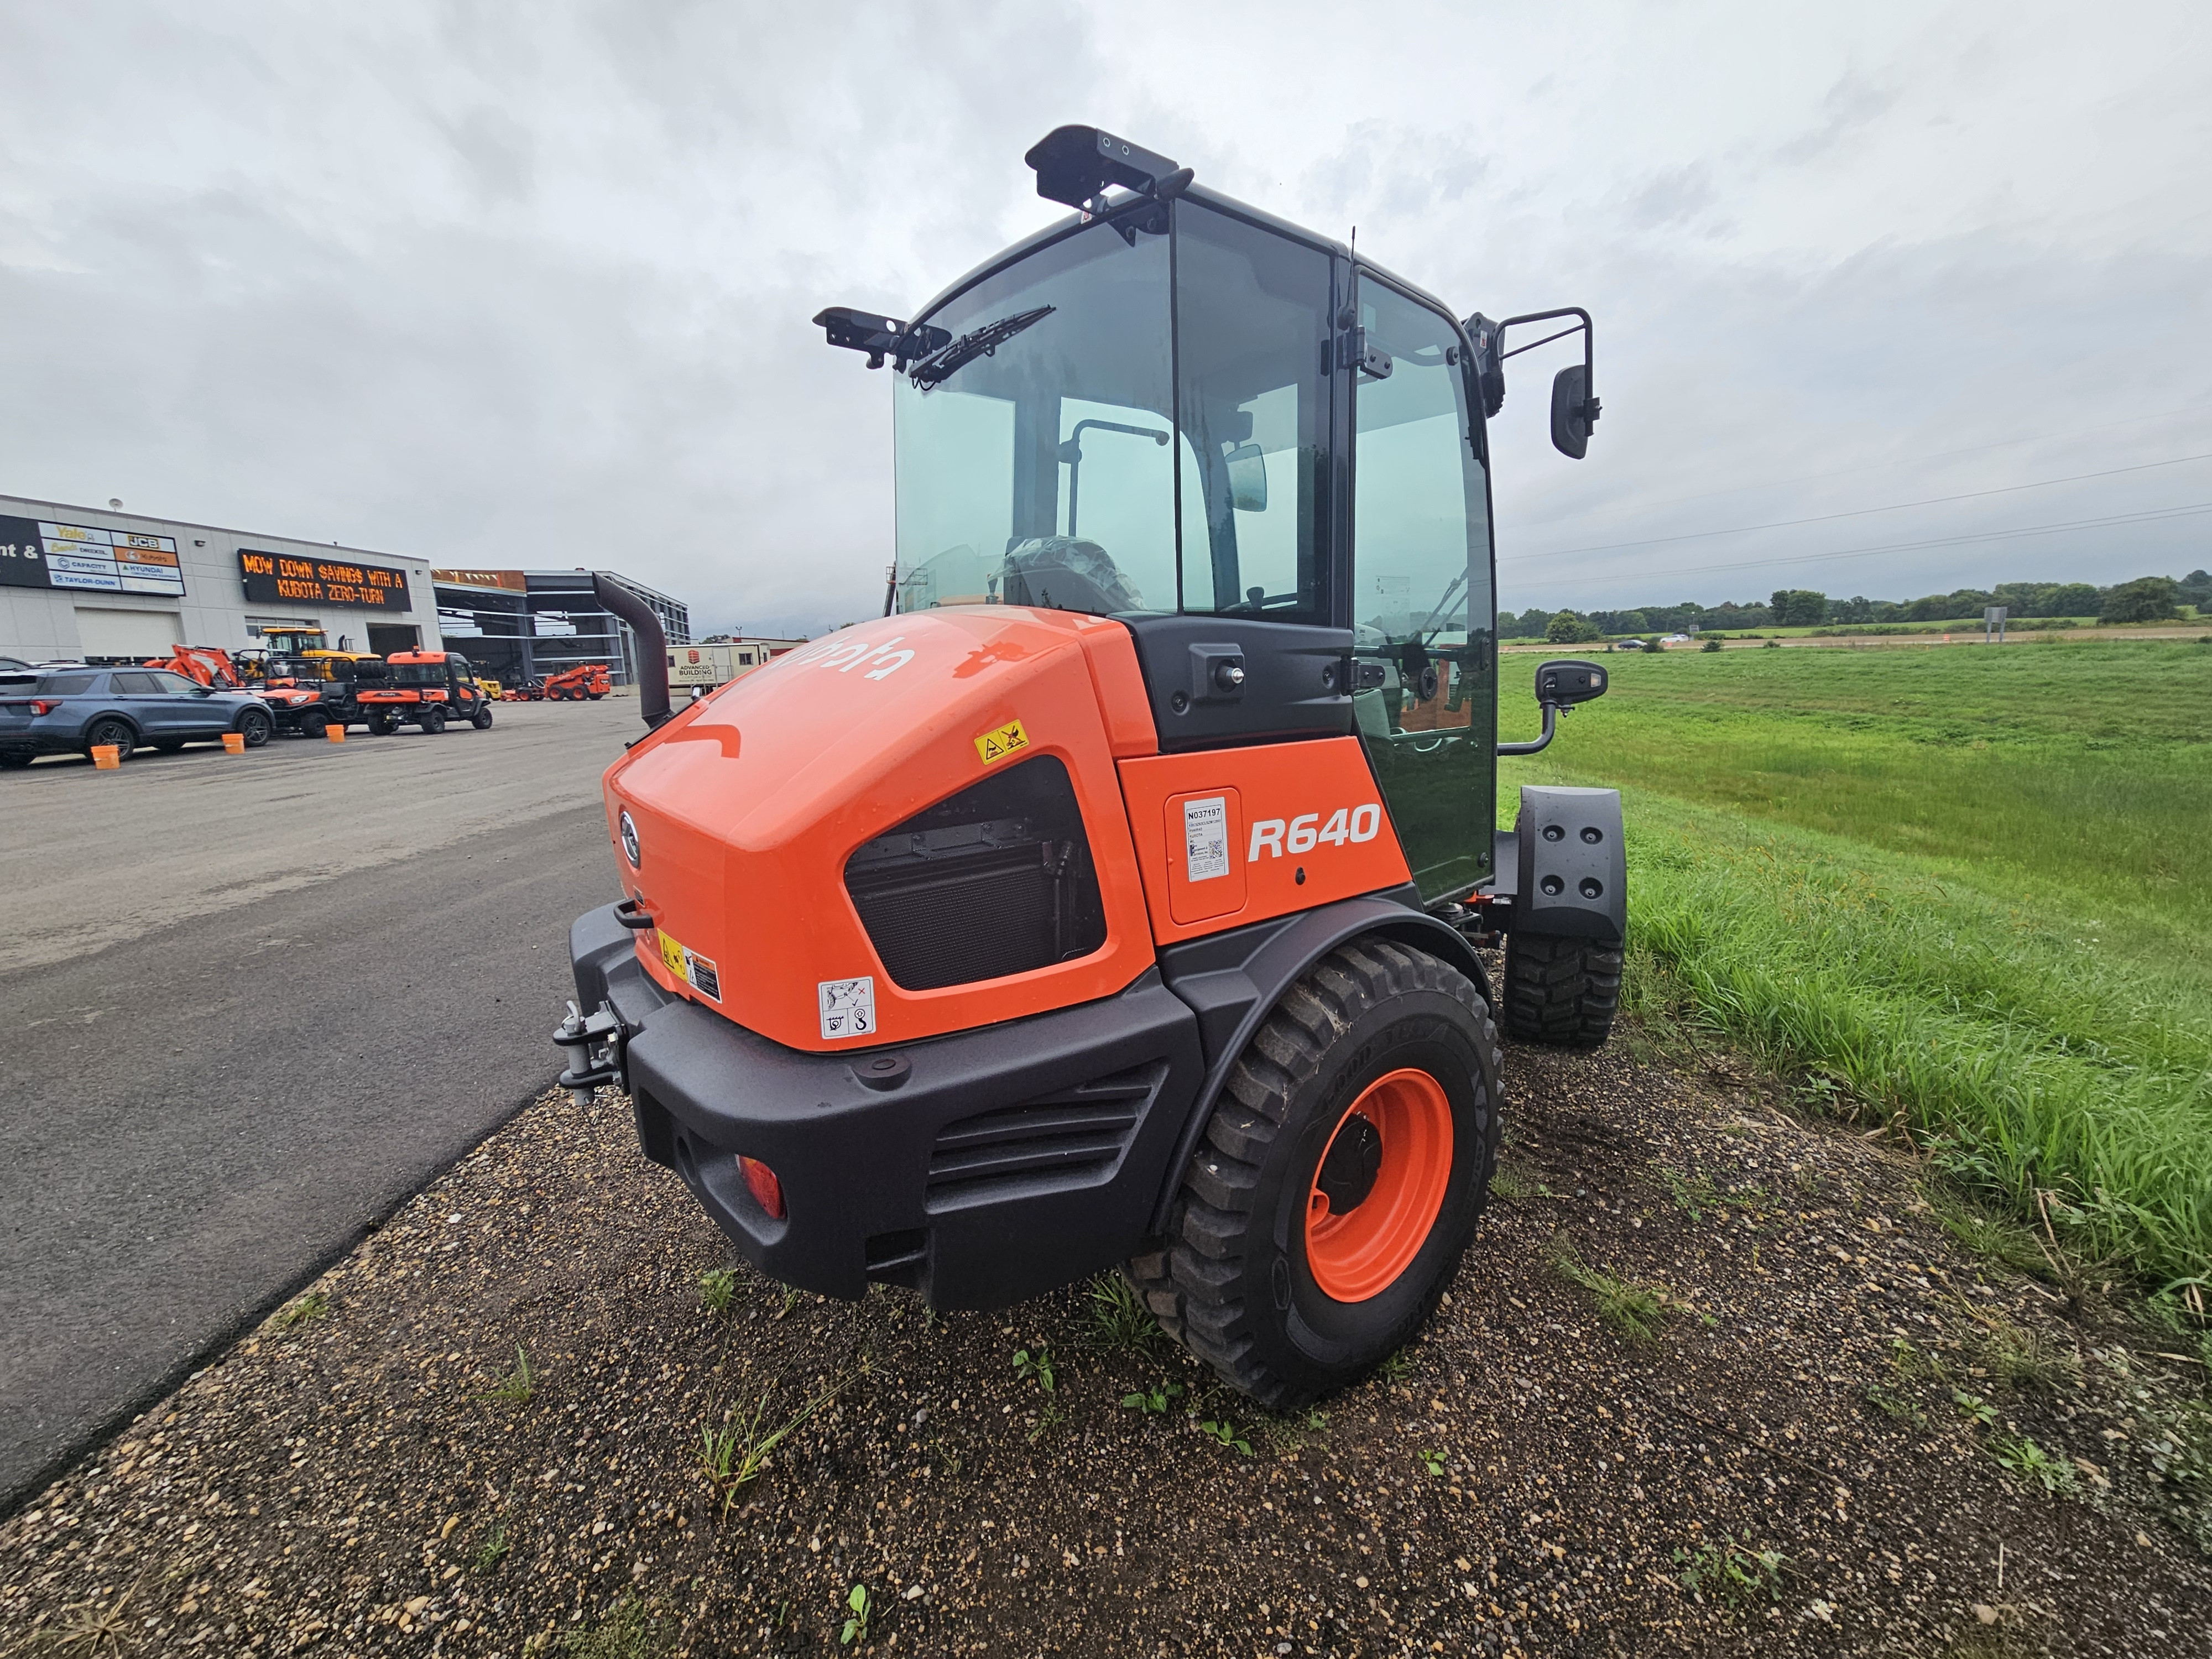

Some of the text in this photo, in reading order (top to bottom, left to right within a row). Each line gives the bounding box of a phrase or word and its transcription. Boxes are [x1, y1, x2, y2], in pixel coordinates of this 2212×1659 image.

[56, 526, 86, 540] Yale
[130, 536, 159, 548] JCB
[24, 545, 38, 559] &
[130, 565, 163, 573] HYUNDAI
[243, 554, 403, 588] MOW DOWN $AVING$ WITH A
[65, 577, 116, 586] TAYLOR-DUNN
[277, 579, 384, 604] KUBOTA ZERO-TURN
[1188, 808, 1220, 820] N037197
[1248, 804, 1380, 862] R640
